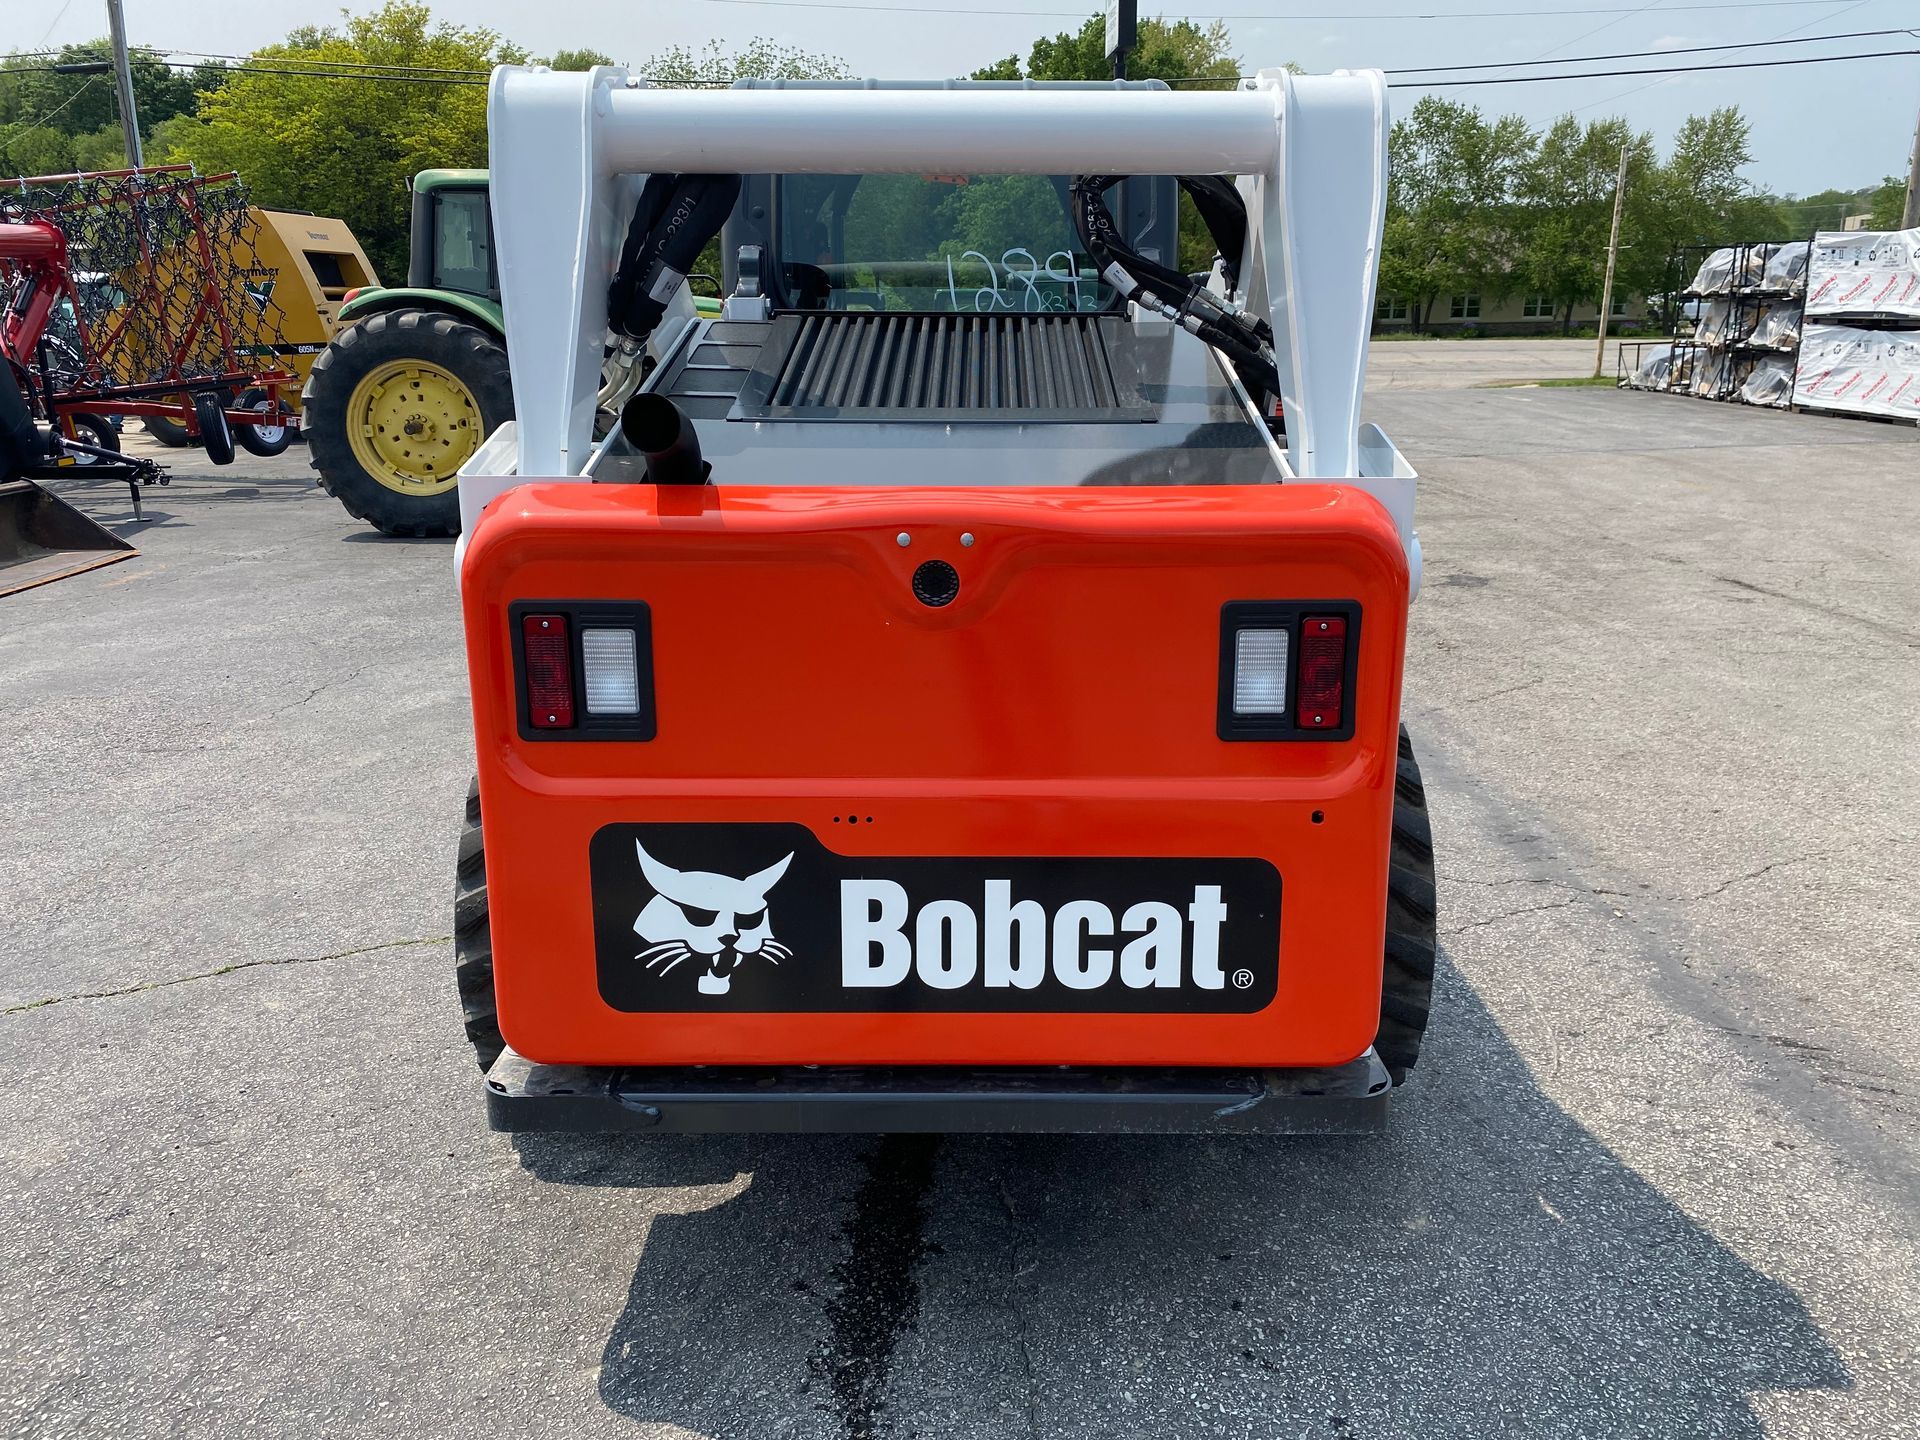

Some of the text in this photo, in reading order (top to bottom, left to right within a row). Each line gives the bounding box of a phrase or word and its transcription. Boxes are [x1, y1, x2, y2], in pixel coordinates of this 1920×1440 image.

[230, 266, 280, 277] ermeer
[947, 247, 1082, 313] 1289
[840, 879, 1227, 990] Bobcat
